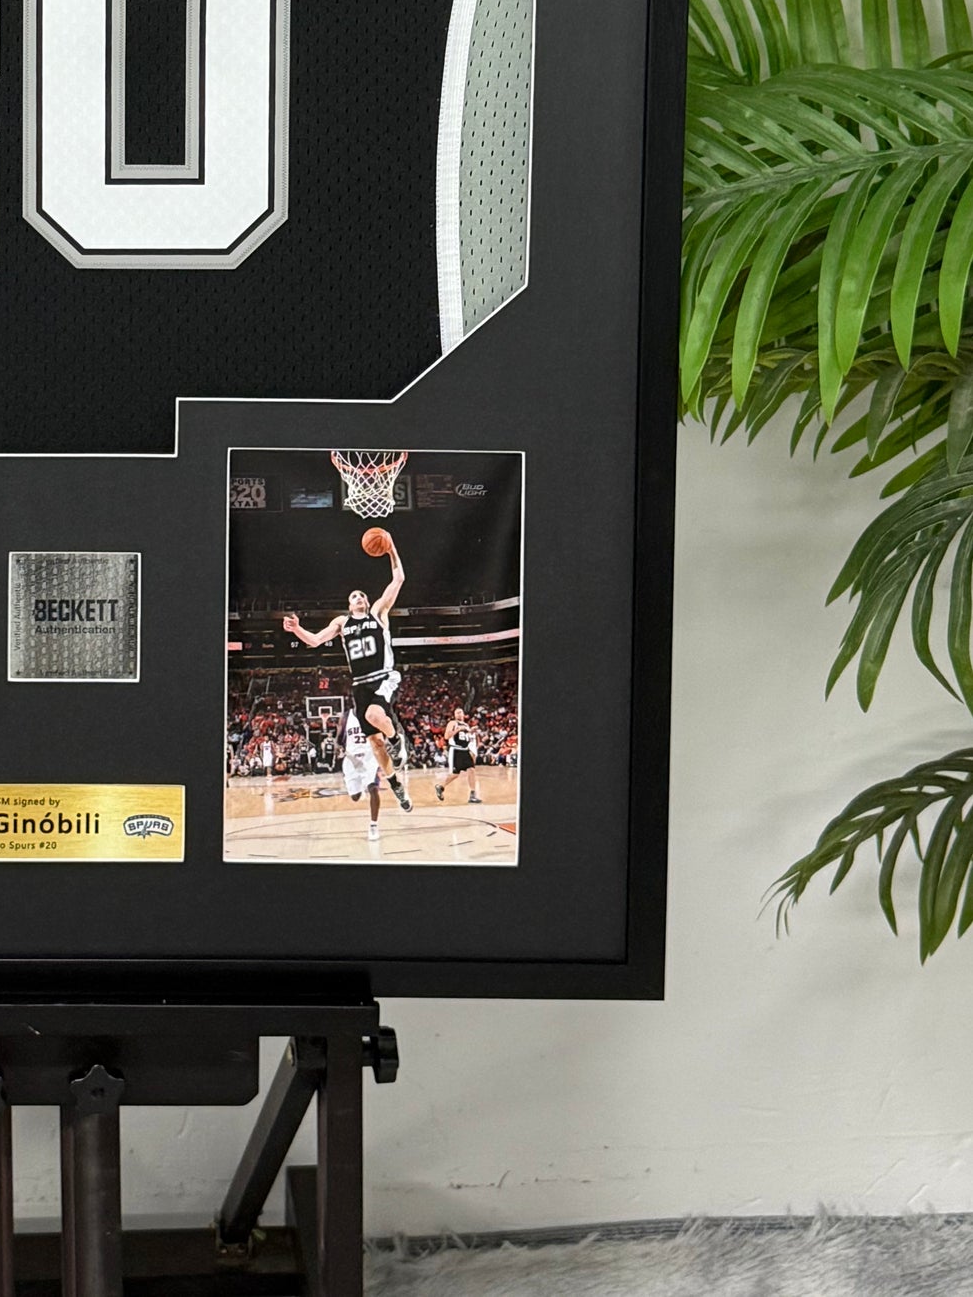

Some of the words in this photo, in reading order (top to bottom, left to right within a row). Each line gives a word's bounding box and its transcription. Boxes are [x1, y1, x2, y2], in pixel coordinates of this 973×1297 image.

[34, 599, 119, 622] BECKETT
[34, 625, 116, 634] Authentication
[348, 636, 377, 660] 20
[13, 797, 45, 808] signed
[48, 797, 61, 808] by
[127, 820, 169, 832] SPURS
[9, 841, 36, 851] Spurs
[39, 841, 58, 850] #20
